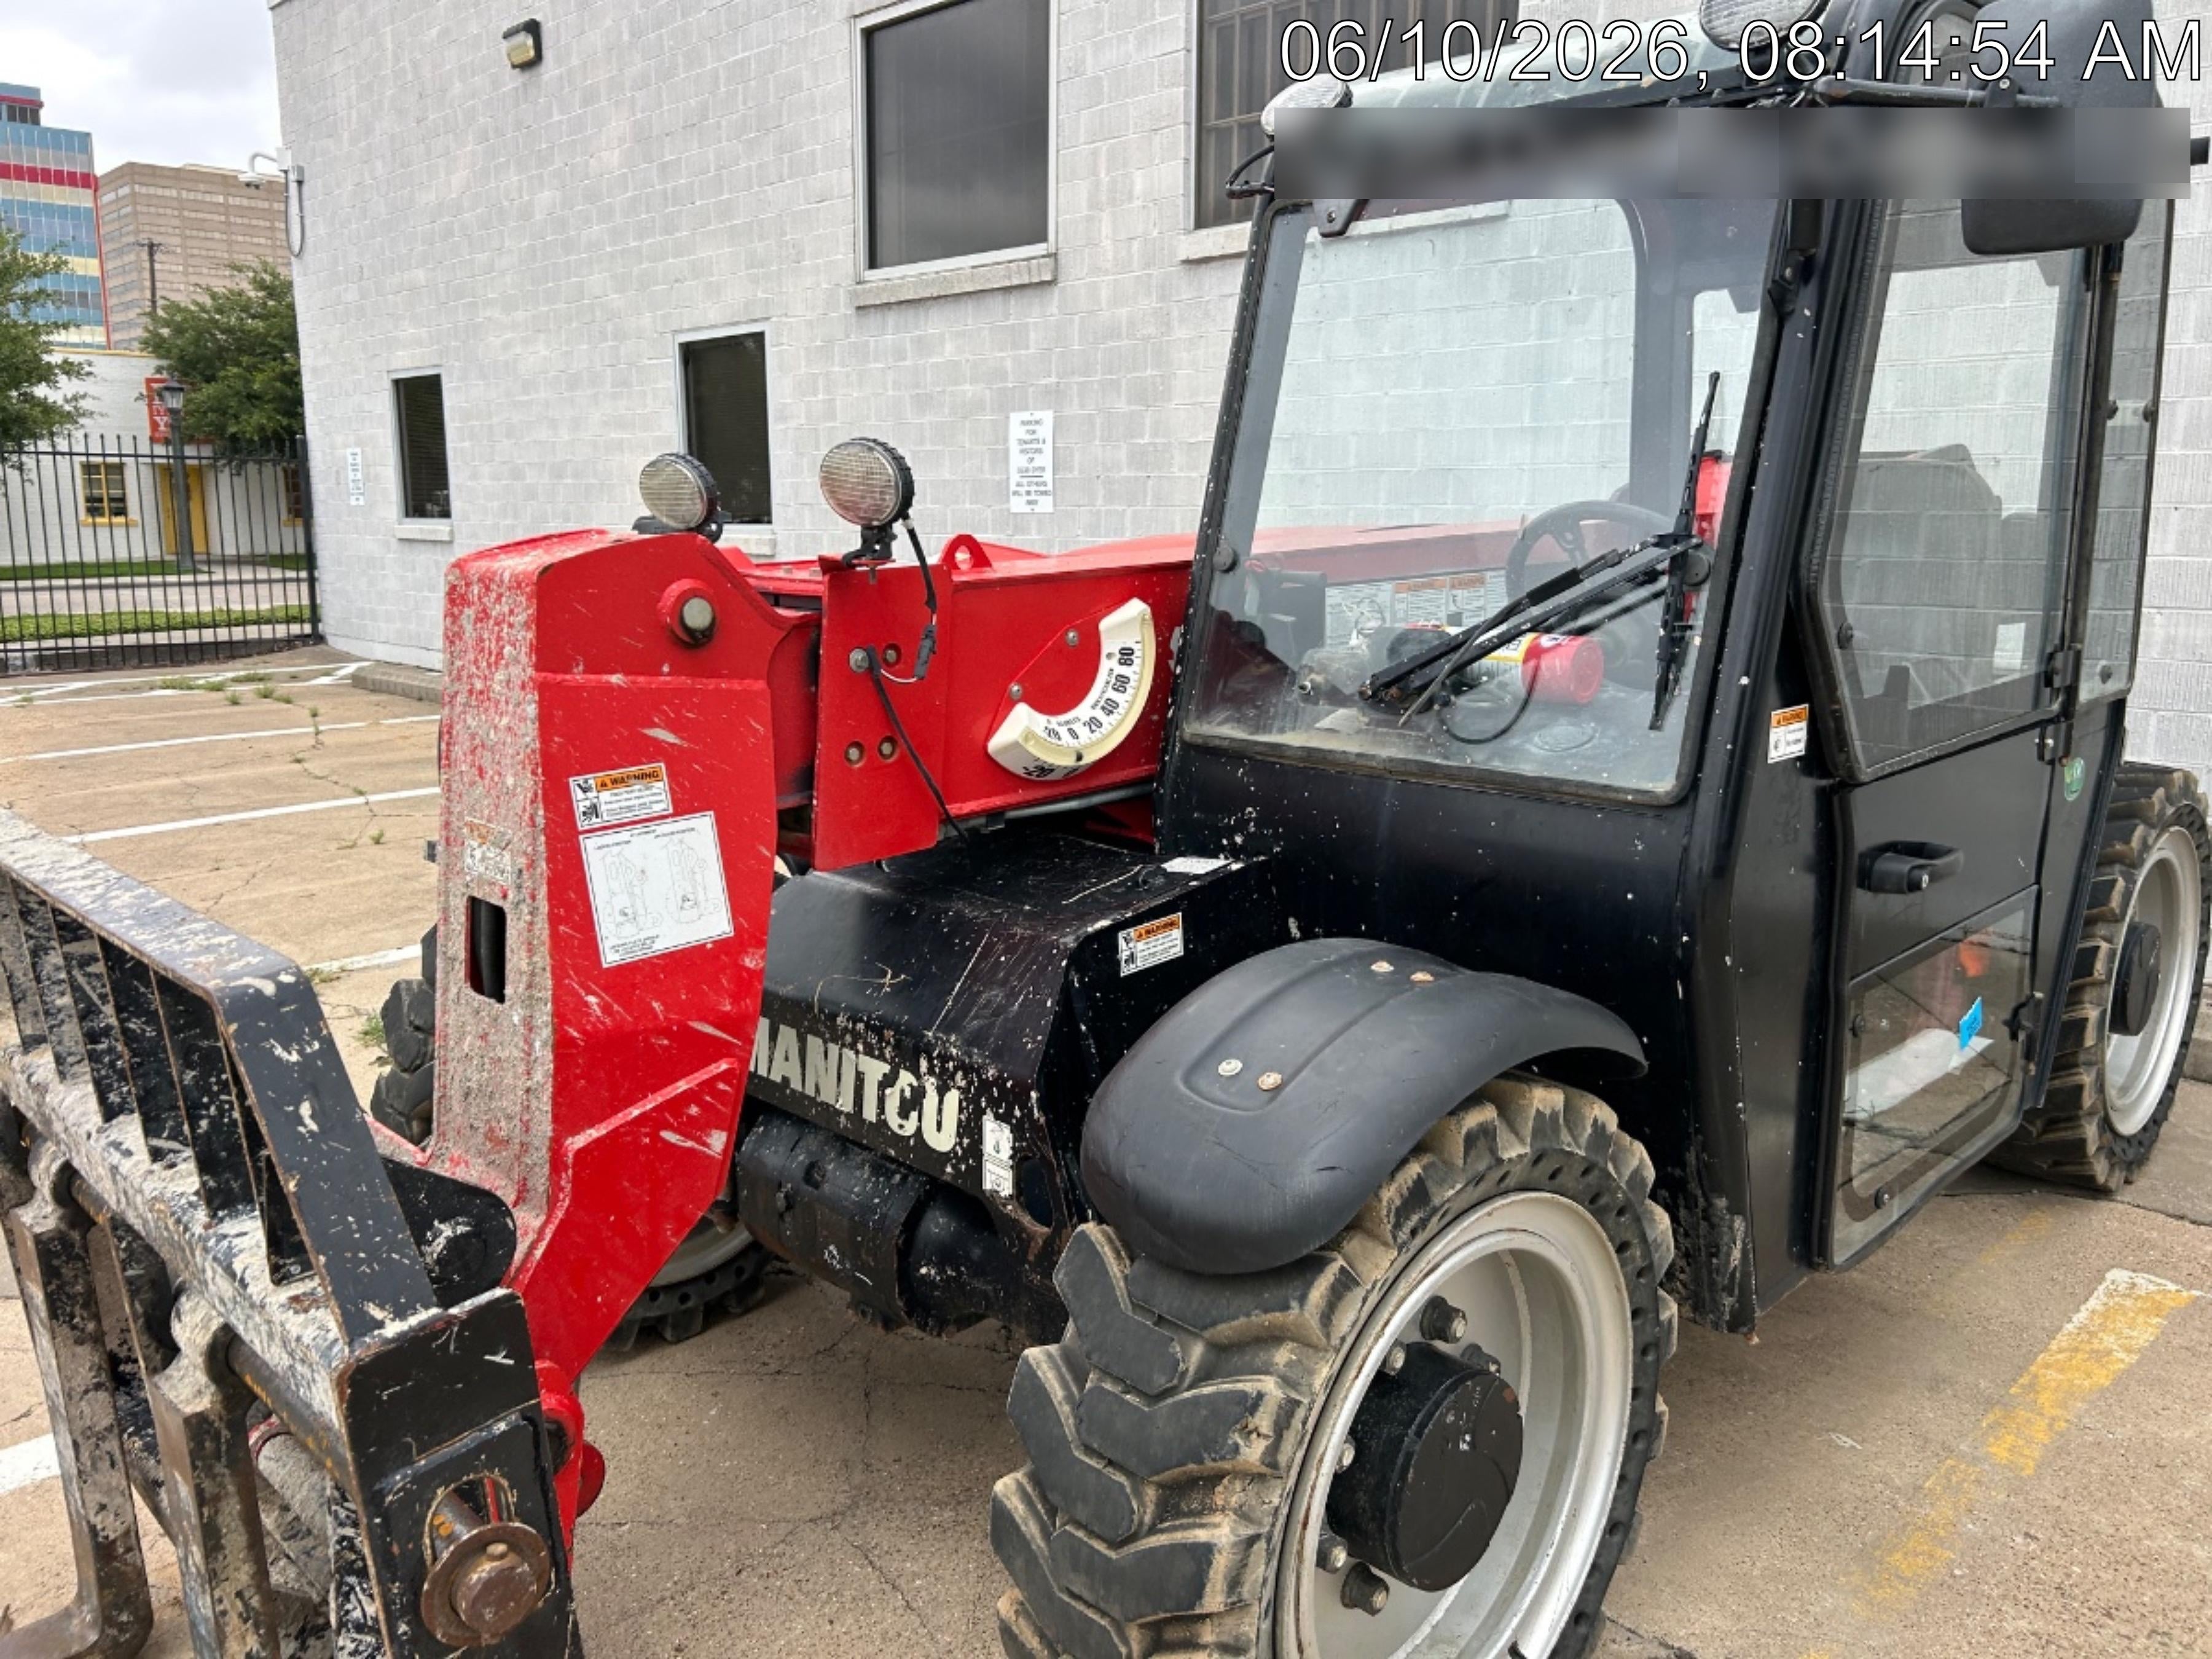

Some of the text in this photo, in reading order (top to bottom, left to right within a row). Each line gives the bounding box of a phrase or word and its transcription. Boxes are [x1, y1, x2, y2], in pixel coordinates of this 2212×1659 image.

[1118, 647, 1134, 666] 80
[1112, 674, 1130, 694] 60
[1100, 698, 1120, 716] 40
[1083, 716, 1103, 734] 20
